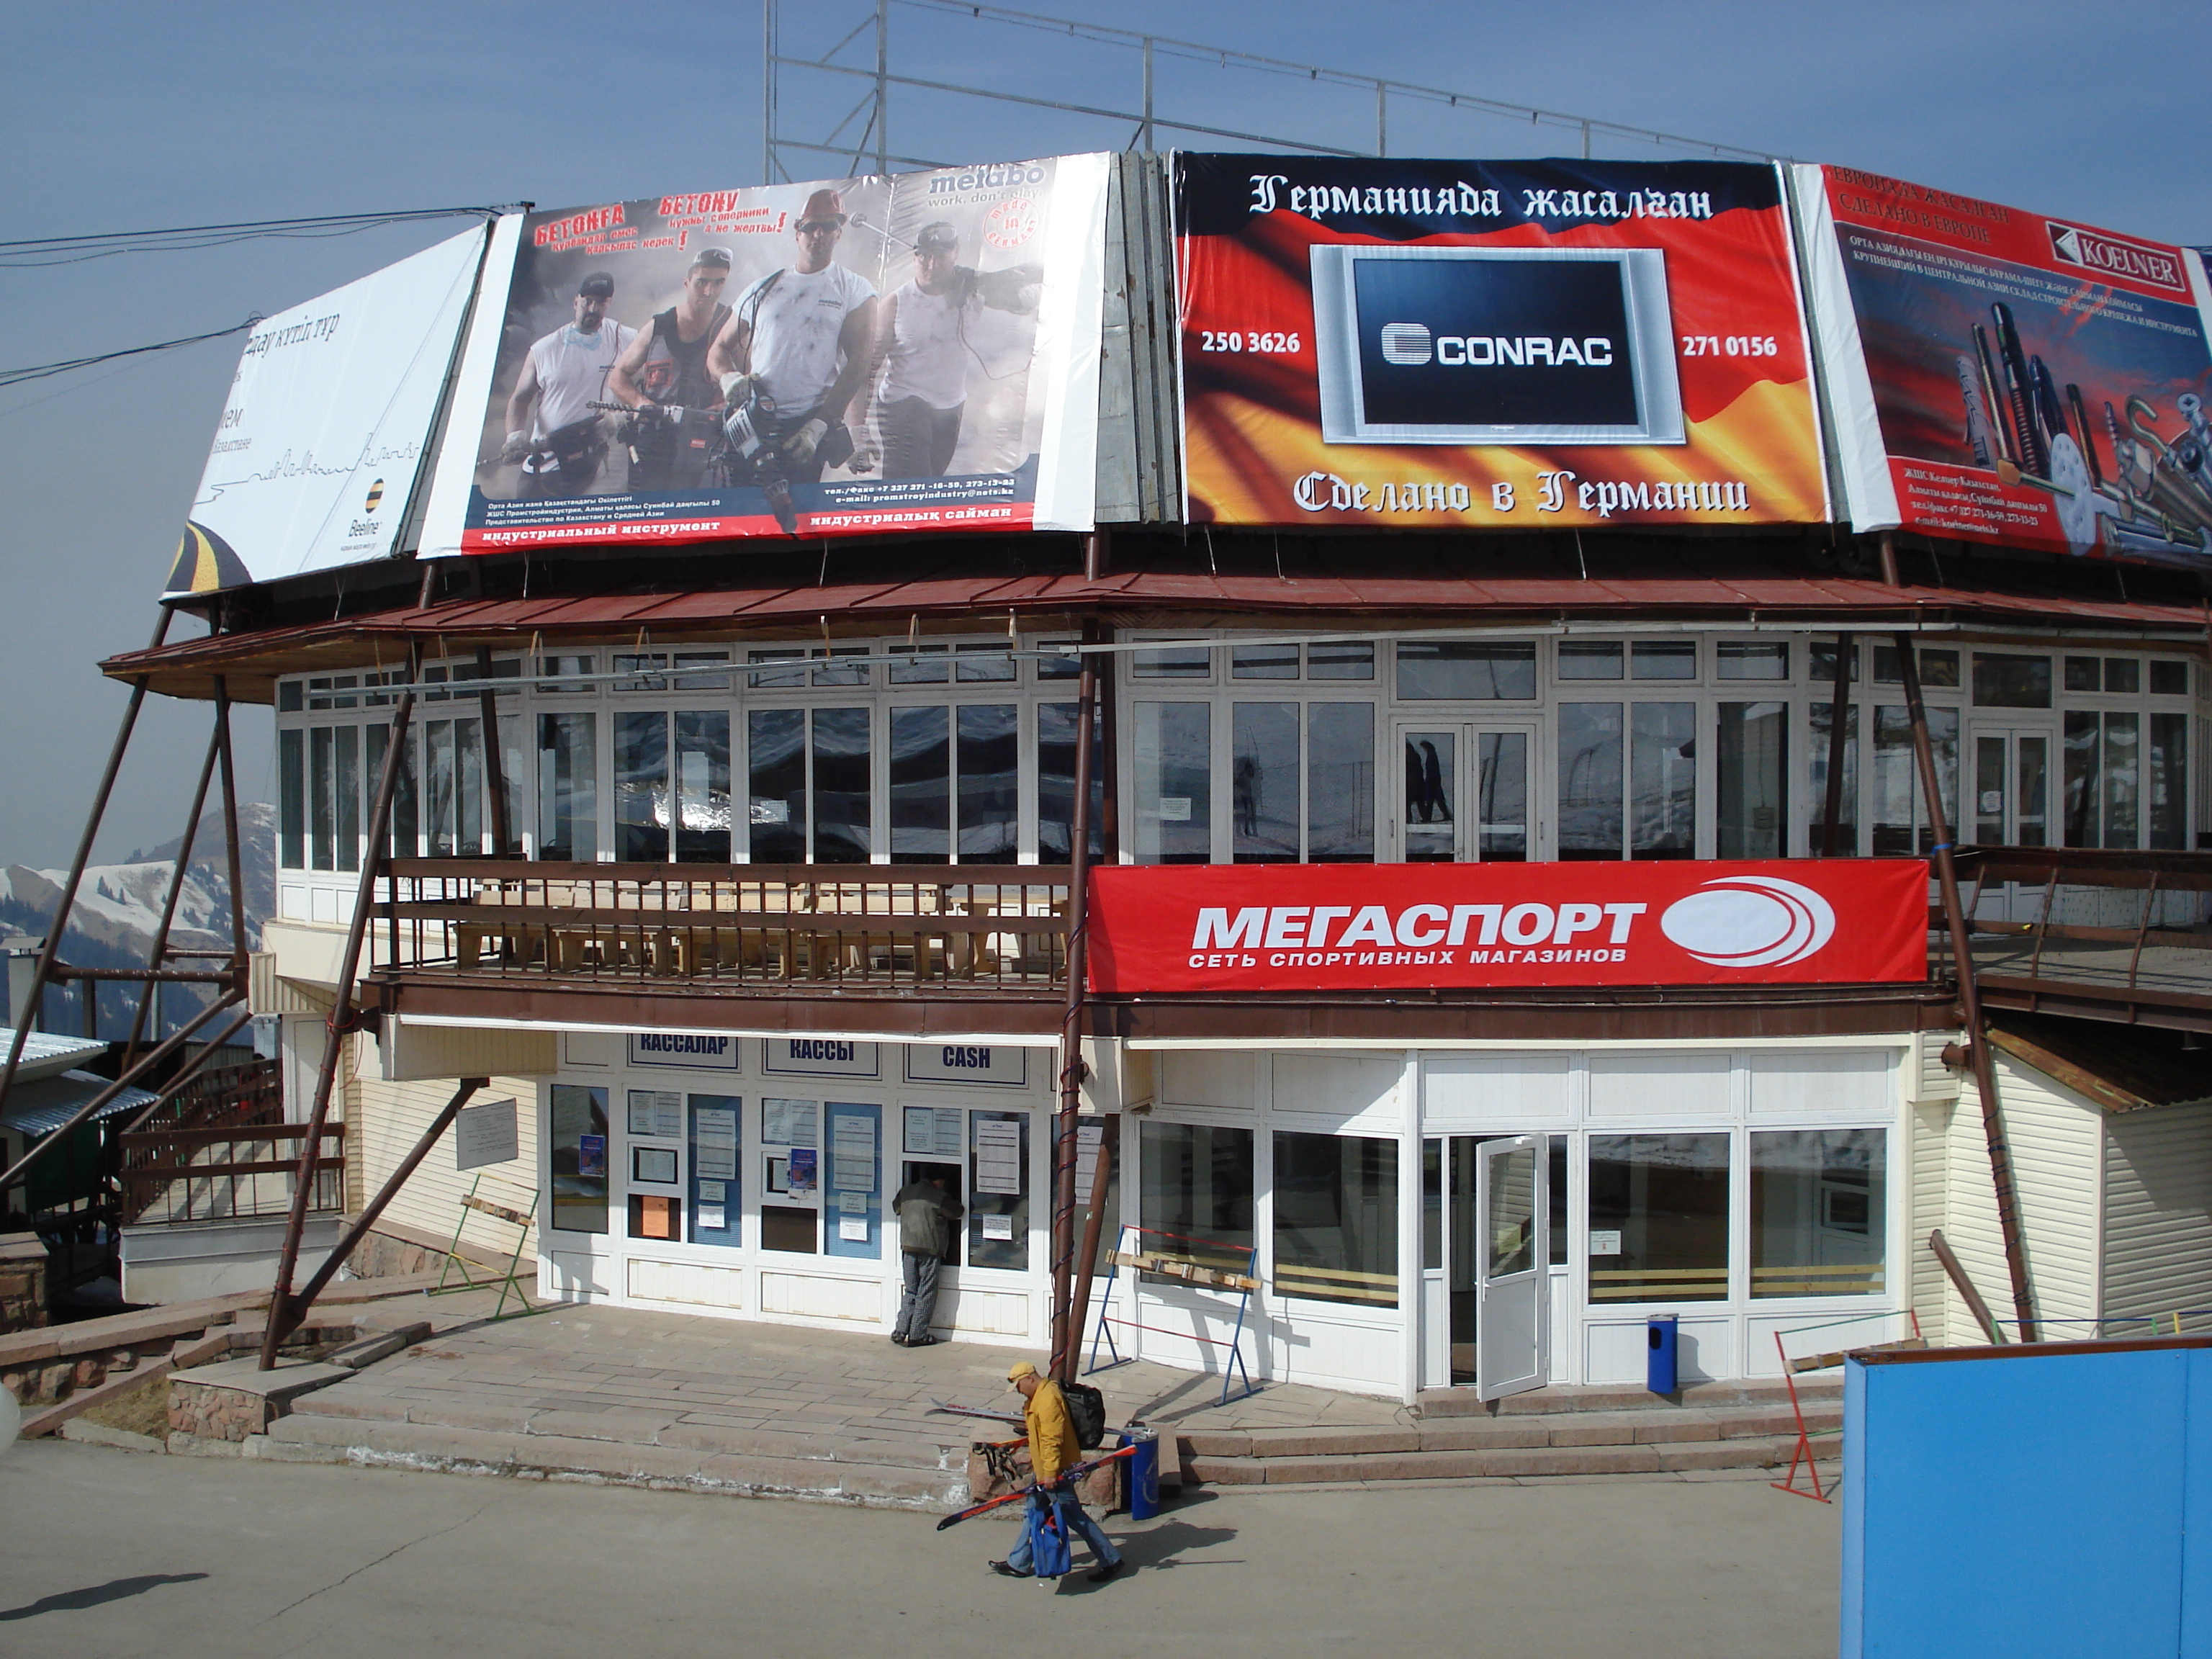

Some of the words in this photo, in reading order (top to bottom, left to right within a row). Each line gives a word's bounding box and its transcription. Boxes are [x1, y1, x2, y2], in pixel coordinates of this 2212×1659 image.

[930, 166, 1044, 193] metabo
[1833, 166, 1920, 200] ЕВРОПАДА
[660, 190, 739, 215] БЕТОНУ
[928, 195, 966, 207] work.
[971, 191, 1004, 203] don't
[1249, 174, 1502, 220] Германияда
[670, 217, 706, 228] нужны
[711, 207, 770, 222] соперники
[1839, 194, 1918, 225] СДЕЛАНО
[1921, 212, 1930, 228] В
[1934, 215, 1991, 243] ЕВРОПЕ
[1849, 235, 1874, 249] ОРТА
[2081, 238, 2177, 283] KOELNER
[1201, 331, 1243, 352] 250
[1248, 332, 1300, 353] 3626
[1437, 336, 1613, 365] CONRAC
[1682, 336, 1720, 356] 271
[1725, 336, 1778, 356] 0156
[910, 482, 926, 491] 271
[1293, 471, 1470, 512] Сделано
[1491, 482, 1516, 512] в
[1536, 470, 1750, 518] Германии
[835, 495, 871, 504] e-mail:
[945, 508, 1012, 520] сайман
[349, 518, 379, 537] Beeline
[482, 524, 617, 542] индустриальный
[621, 522, 720, 535] инструмент
[1192, 903, 1647, 949] МЕГАСПОРТ
[1188, 954, 1256, 968] СЕТЬ
[1269, 951, 1455, 966] СПОРТИВНЫХ
[1470, 949, 1627, 964] МАГАЗИНОВ
[641, 1034, 728, 1054] КАССАЛАР
[790, 1038, 854, 1061] КАССЫ
[943, 1046, 990, 1069] CASH
